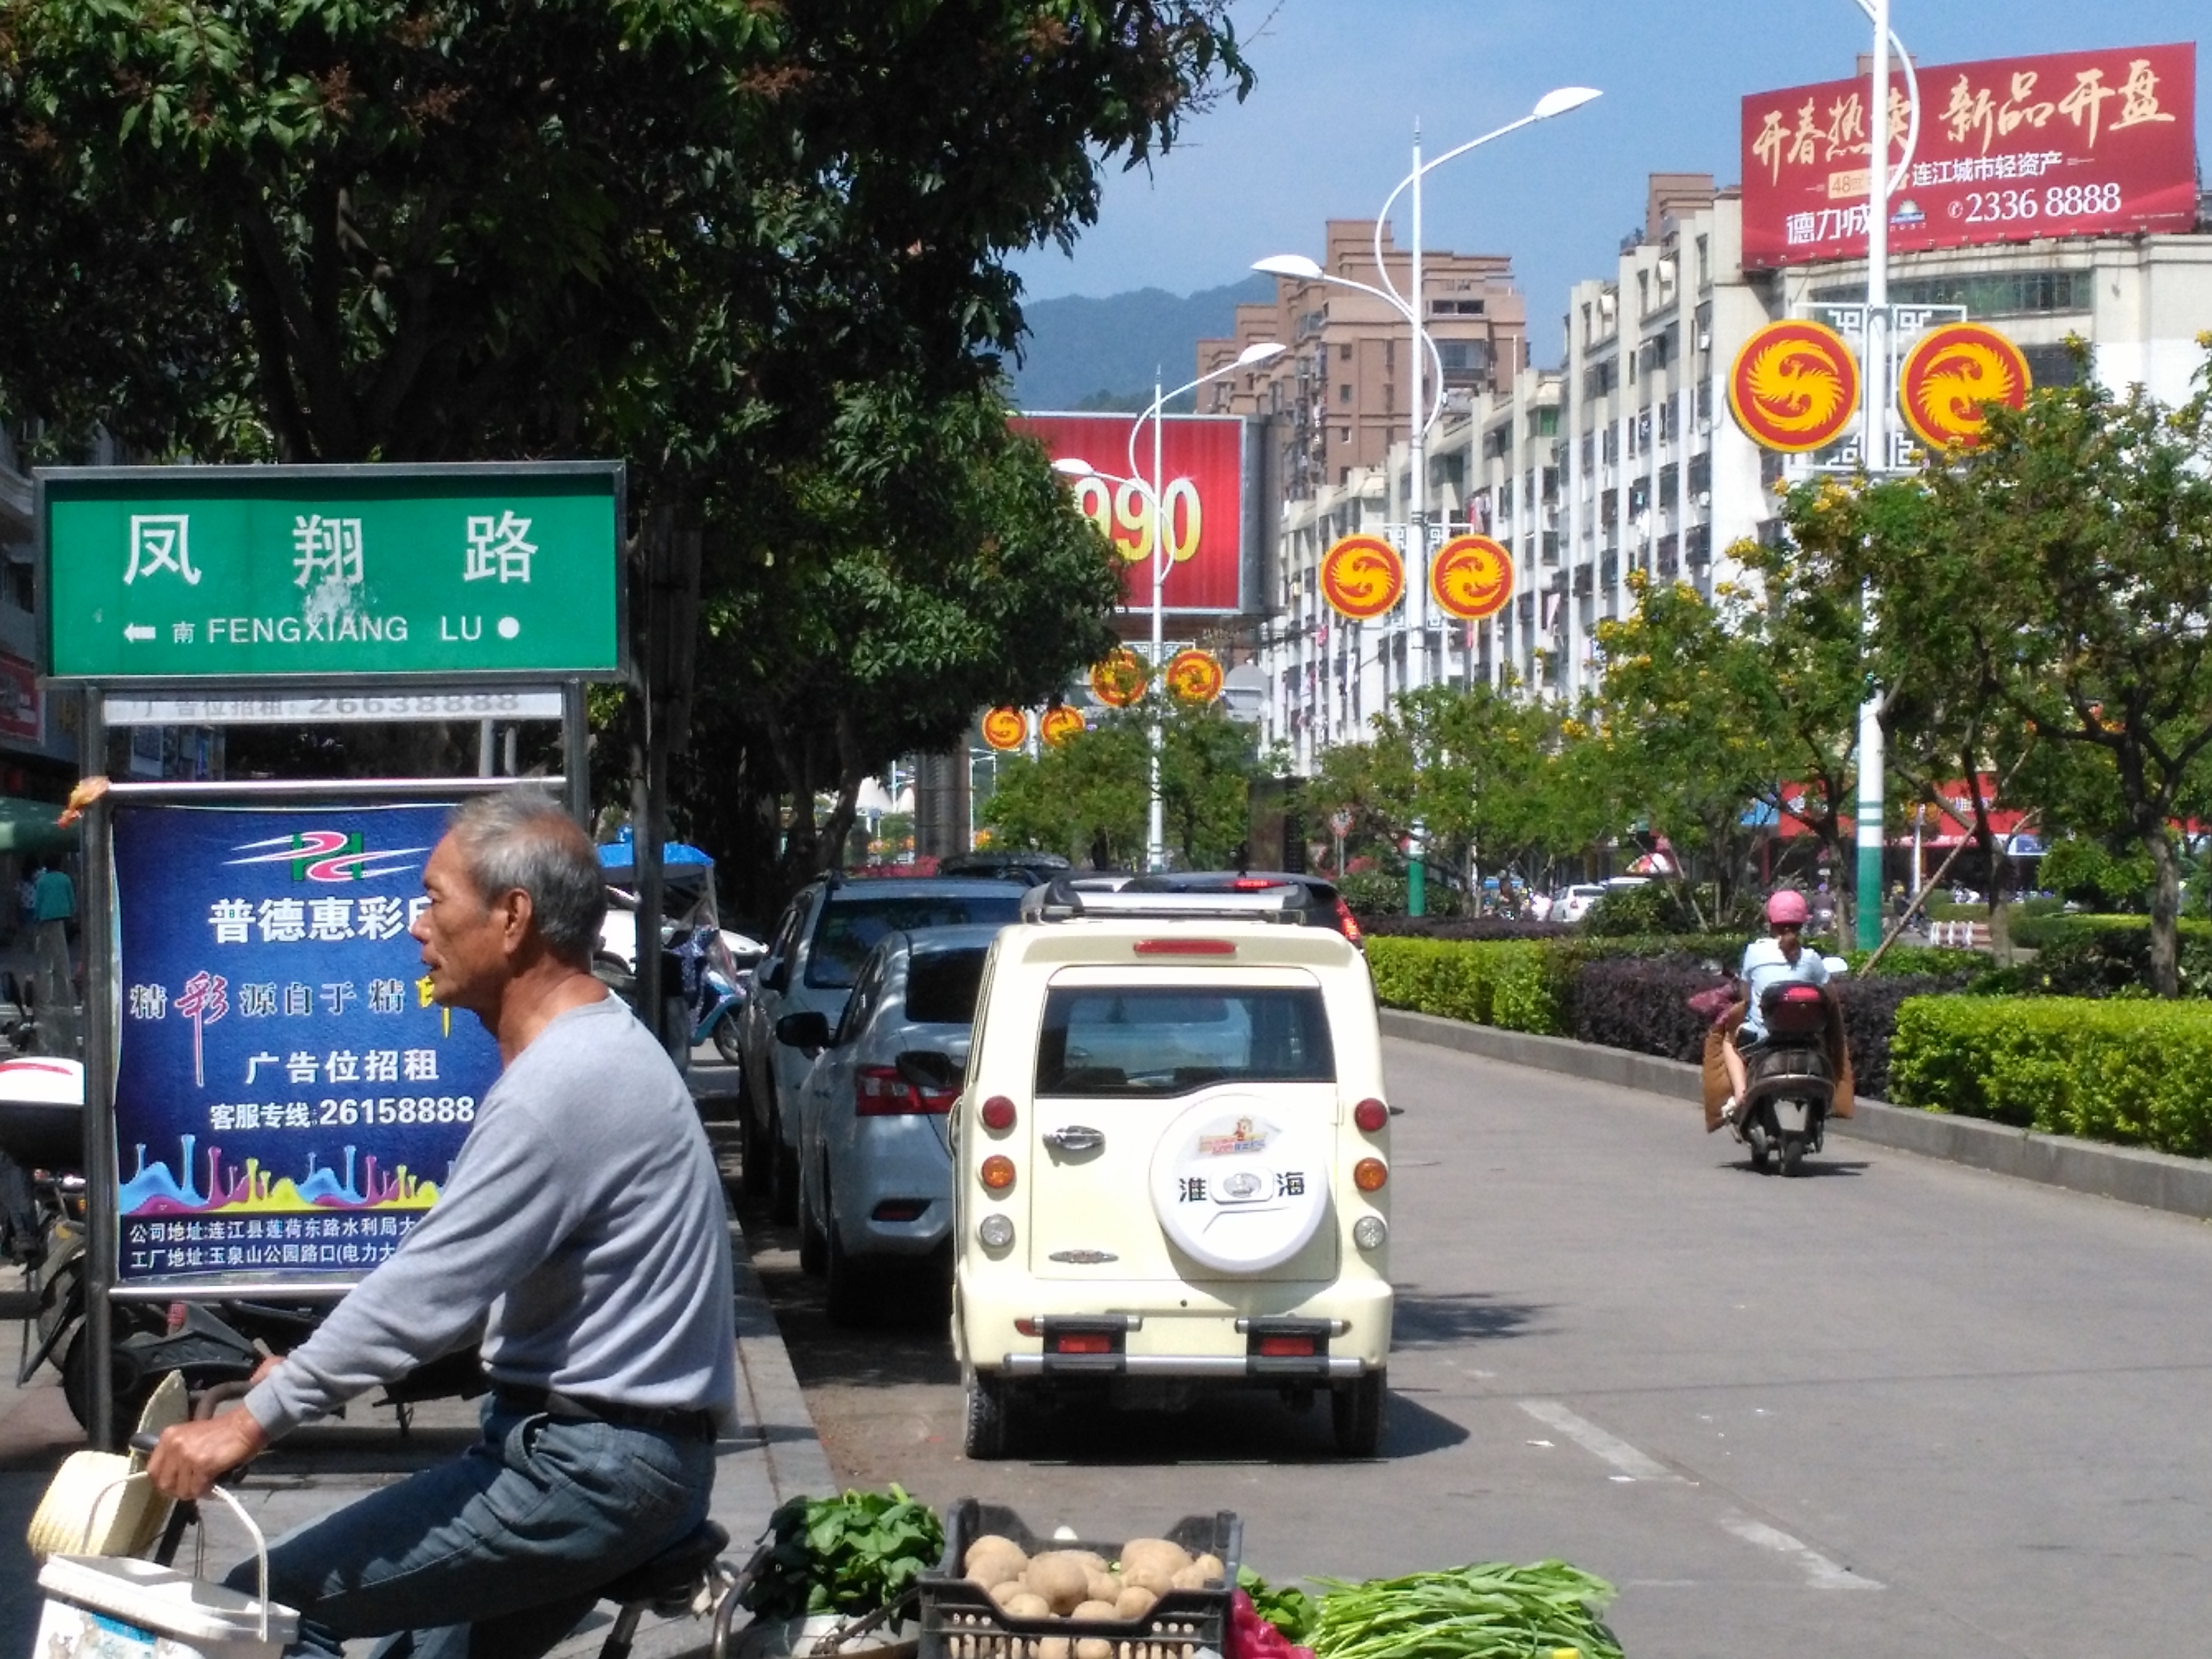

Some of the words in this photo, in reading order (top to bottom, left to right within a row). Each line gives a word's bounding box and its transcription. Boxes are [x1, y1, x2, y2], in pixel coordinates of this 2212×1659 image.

[1940, 59, 2175, 153] 新品开盘
[1913, 151, 2063, 187] 连江城市轻资产
[1966, 193, 2038, 223] 2336
[2045, 183, 2121, 215] 8888
[123, 510, 539, 587] 凤翔路
[172, 622, 195, 643] 南
[208, 617, 409, 643] FENGXIANG
[441, 616, 482, 641] LU
[246, 1049, 440, 1084] 广告位招租
[1179, 1171, 1305, 1203] 淮海
